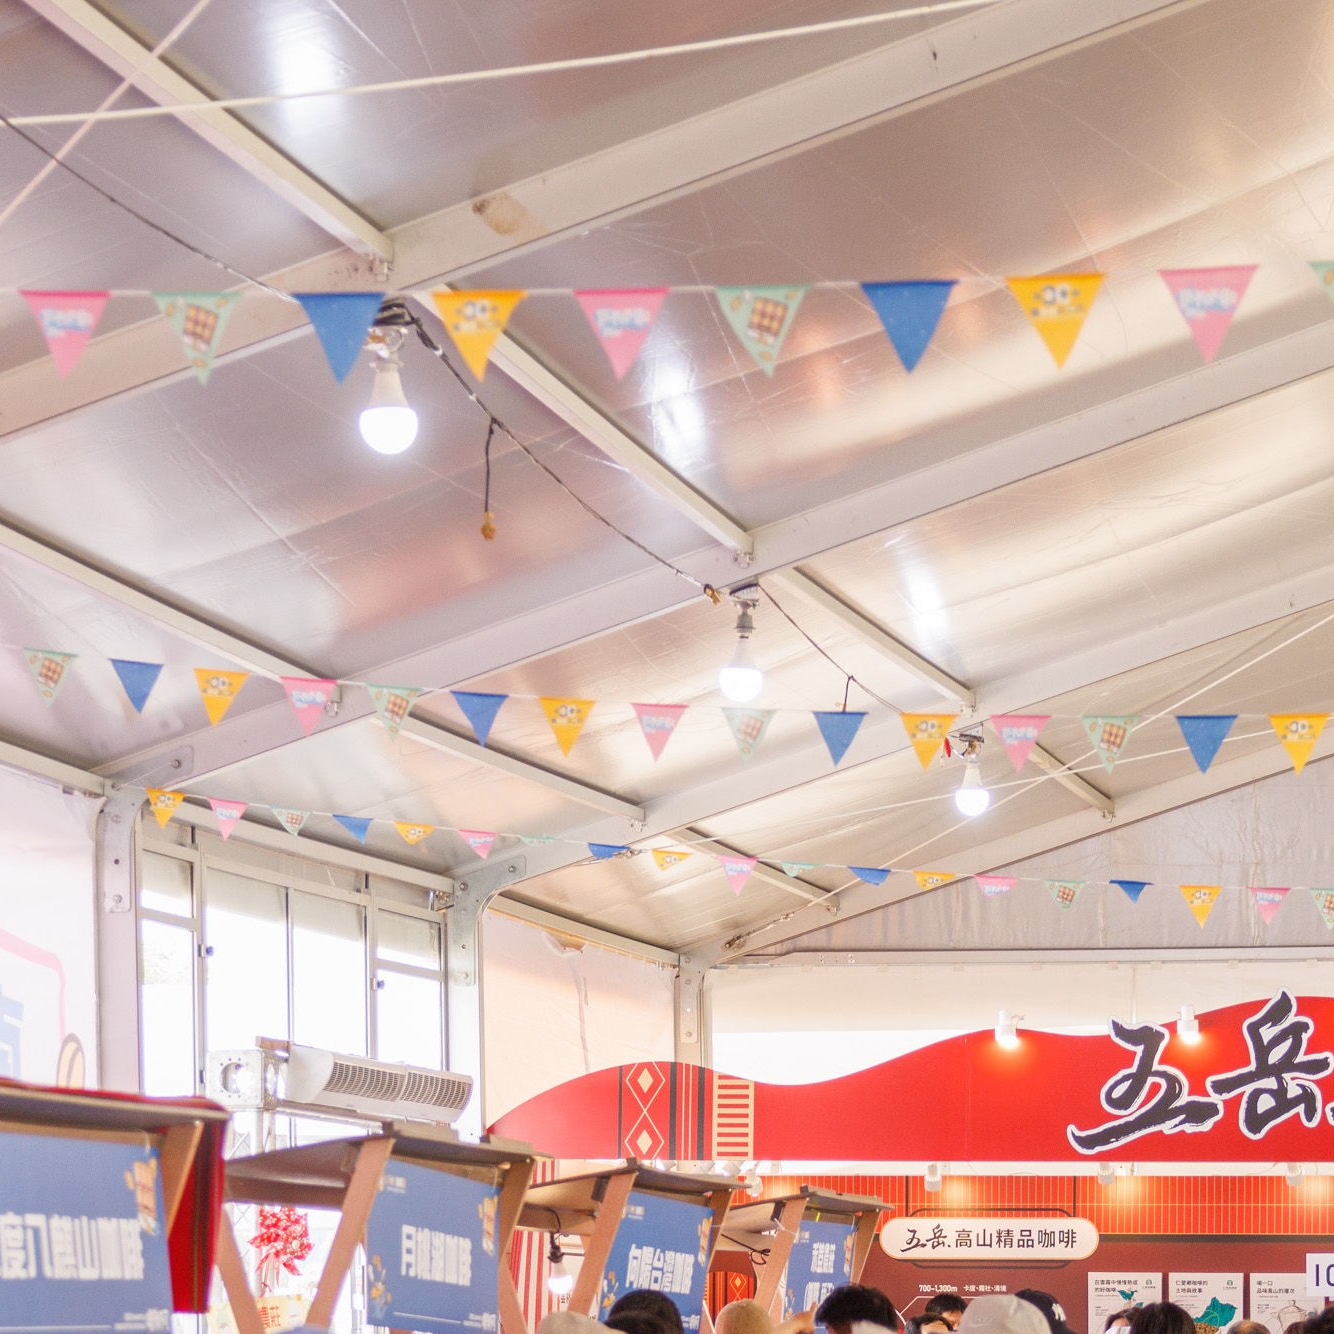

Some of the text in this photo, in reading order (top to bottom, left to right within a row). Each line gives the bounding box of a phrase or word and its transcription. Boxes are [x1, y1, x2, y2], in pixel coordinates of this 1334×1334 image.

[955, 1228, 1077, 1249] 高山精品咖啡
